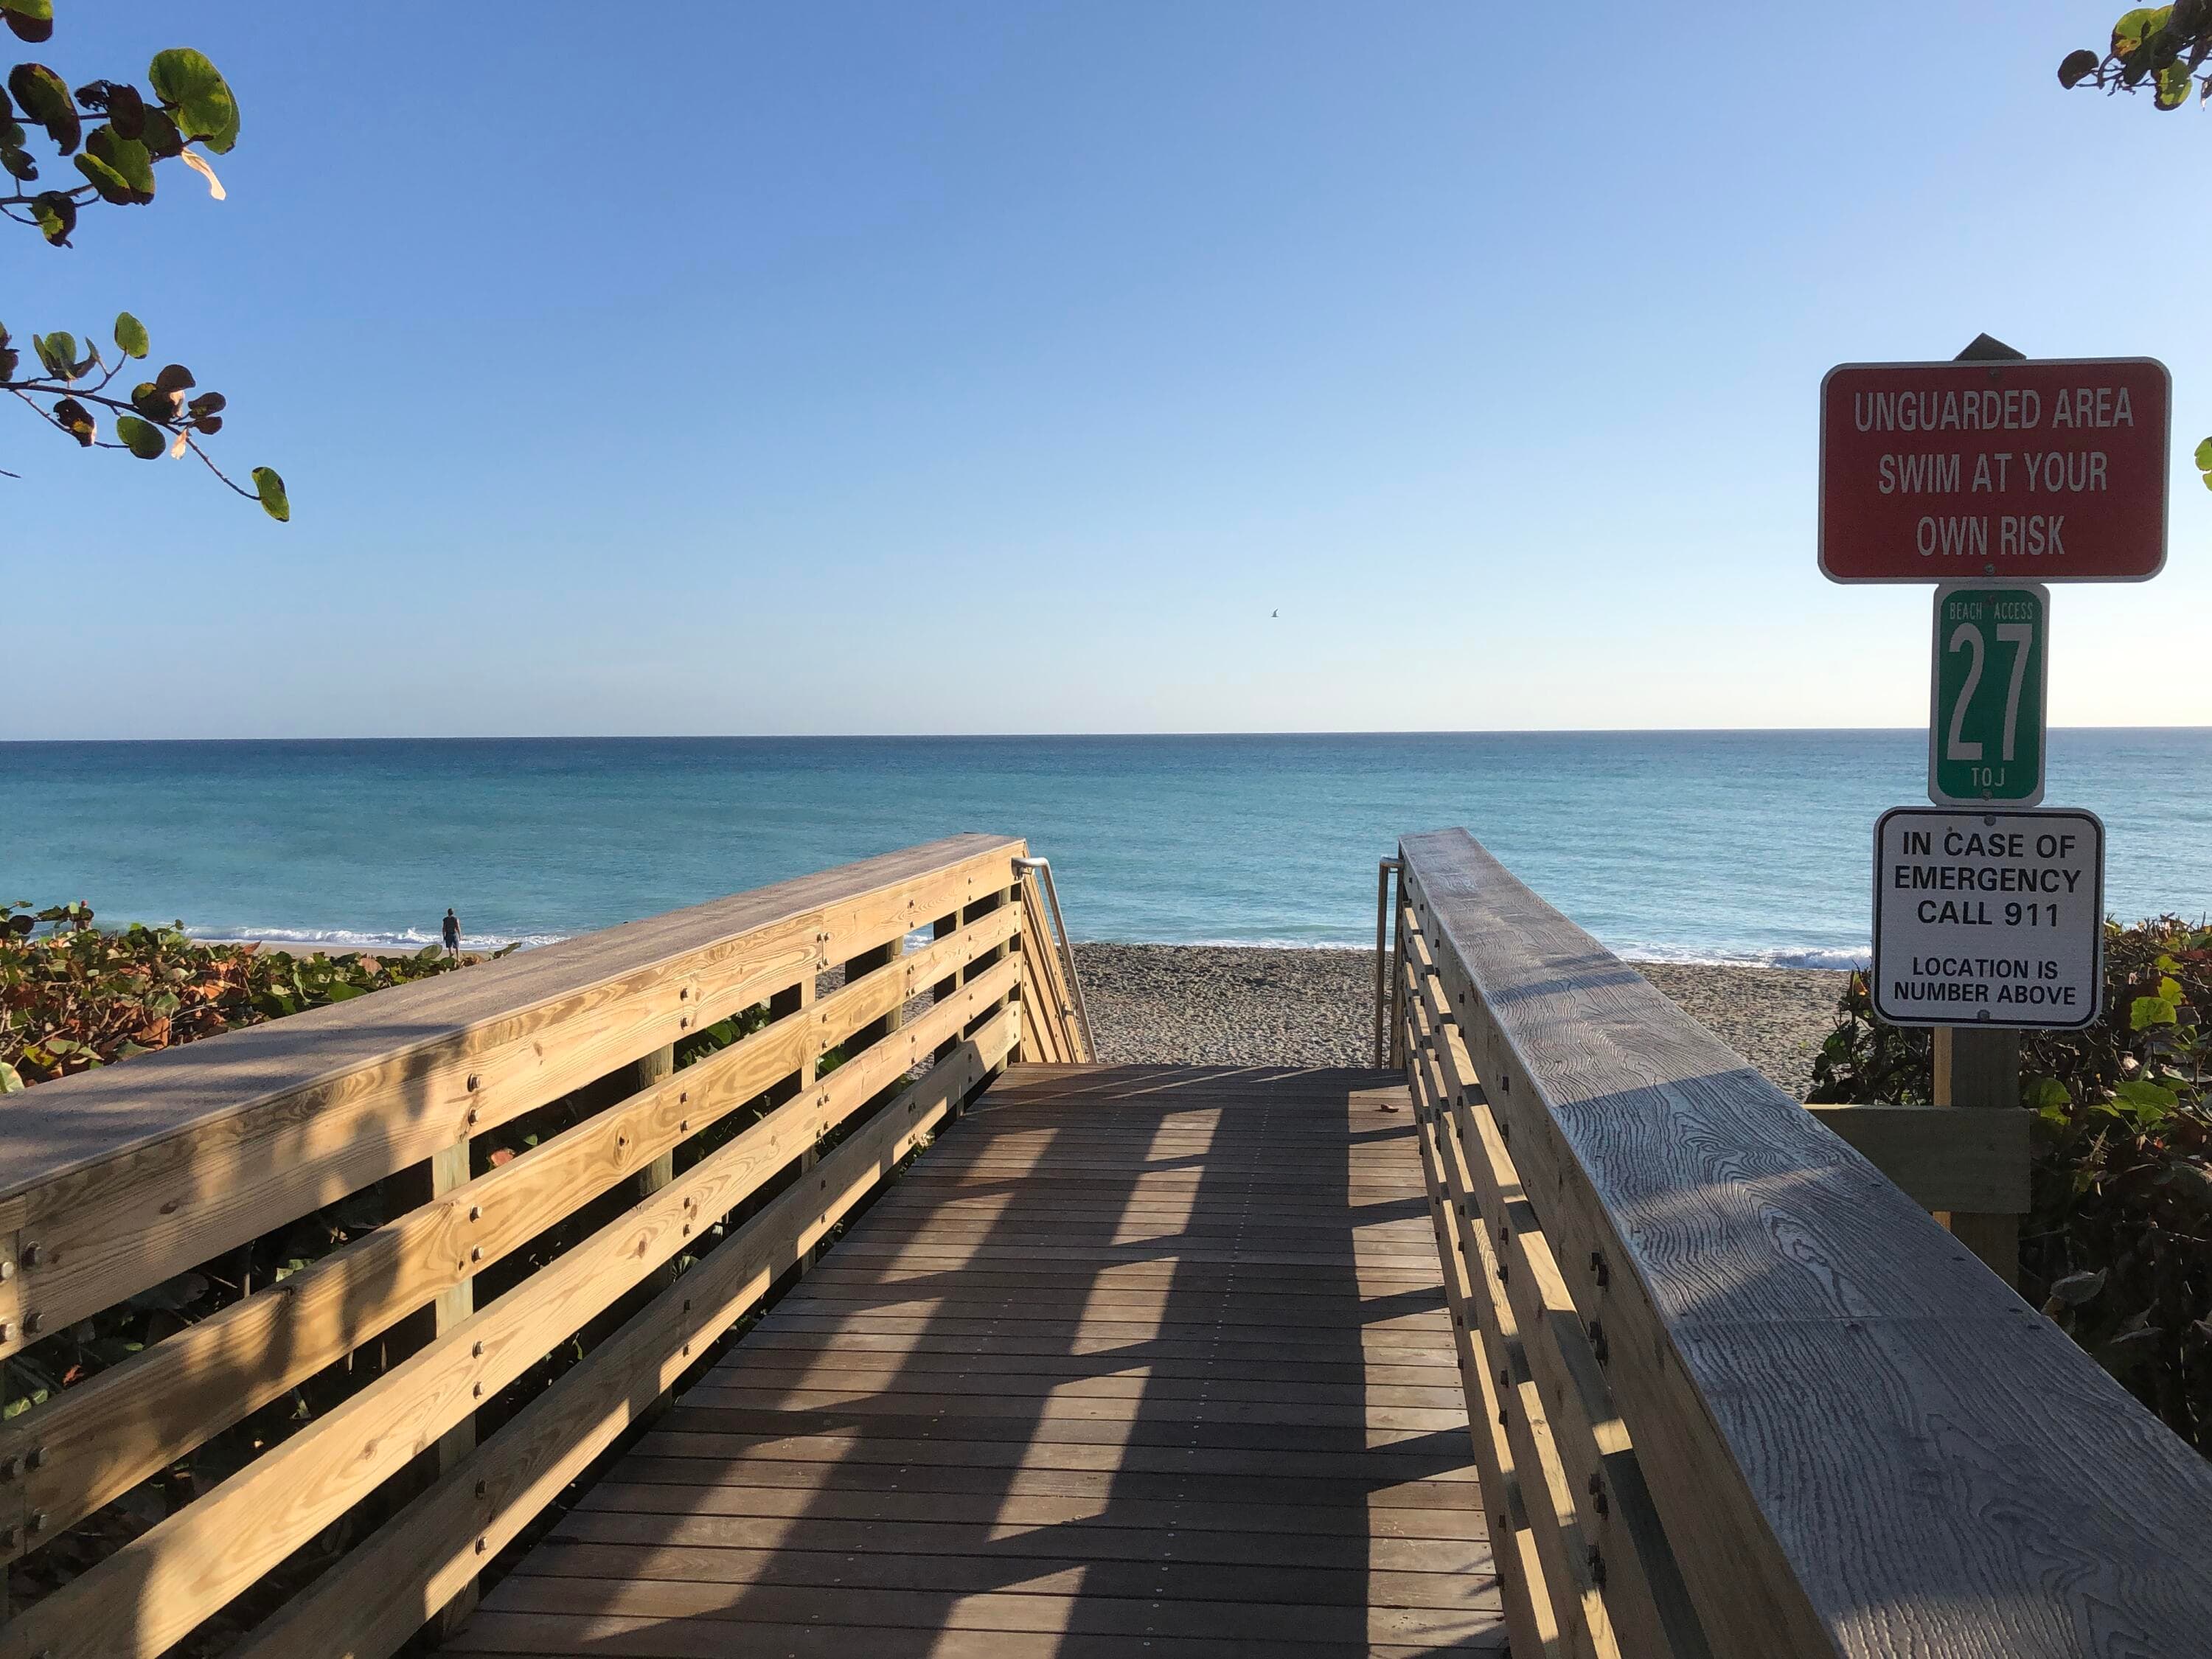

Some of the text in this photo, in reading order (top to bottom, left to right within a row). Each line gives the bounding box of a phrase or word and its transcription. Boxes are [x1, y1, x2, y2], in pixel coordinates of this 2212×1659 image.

[1854, 387, 2135, 432] UNGUARDED AREA
[1879, 451, 2107, 494] SWIM AT YOUR
[1917, 515, 2065, 557] OWN RISK
[1950, 602, 2033, 620] BEACH ACCESS
[1947, 622, 2033, 761] 27
[1971, 767, 2005, 787] TOJ
[1903, 832, 2076, 858] IN CASE OF
[1894, 865, 2081, 893] EMERGENCY
[1917, 900, 2057, 927] CALL 911
[1913, 957, 2058, 979] LOCATION IS
[1894, 981, 2076, 1005] NUMBER ABOVE
